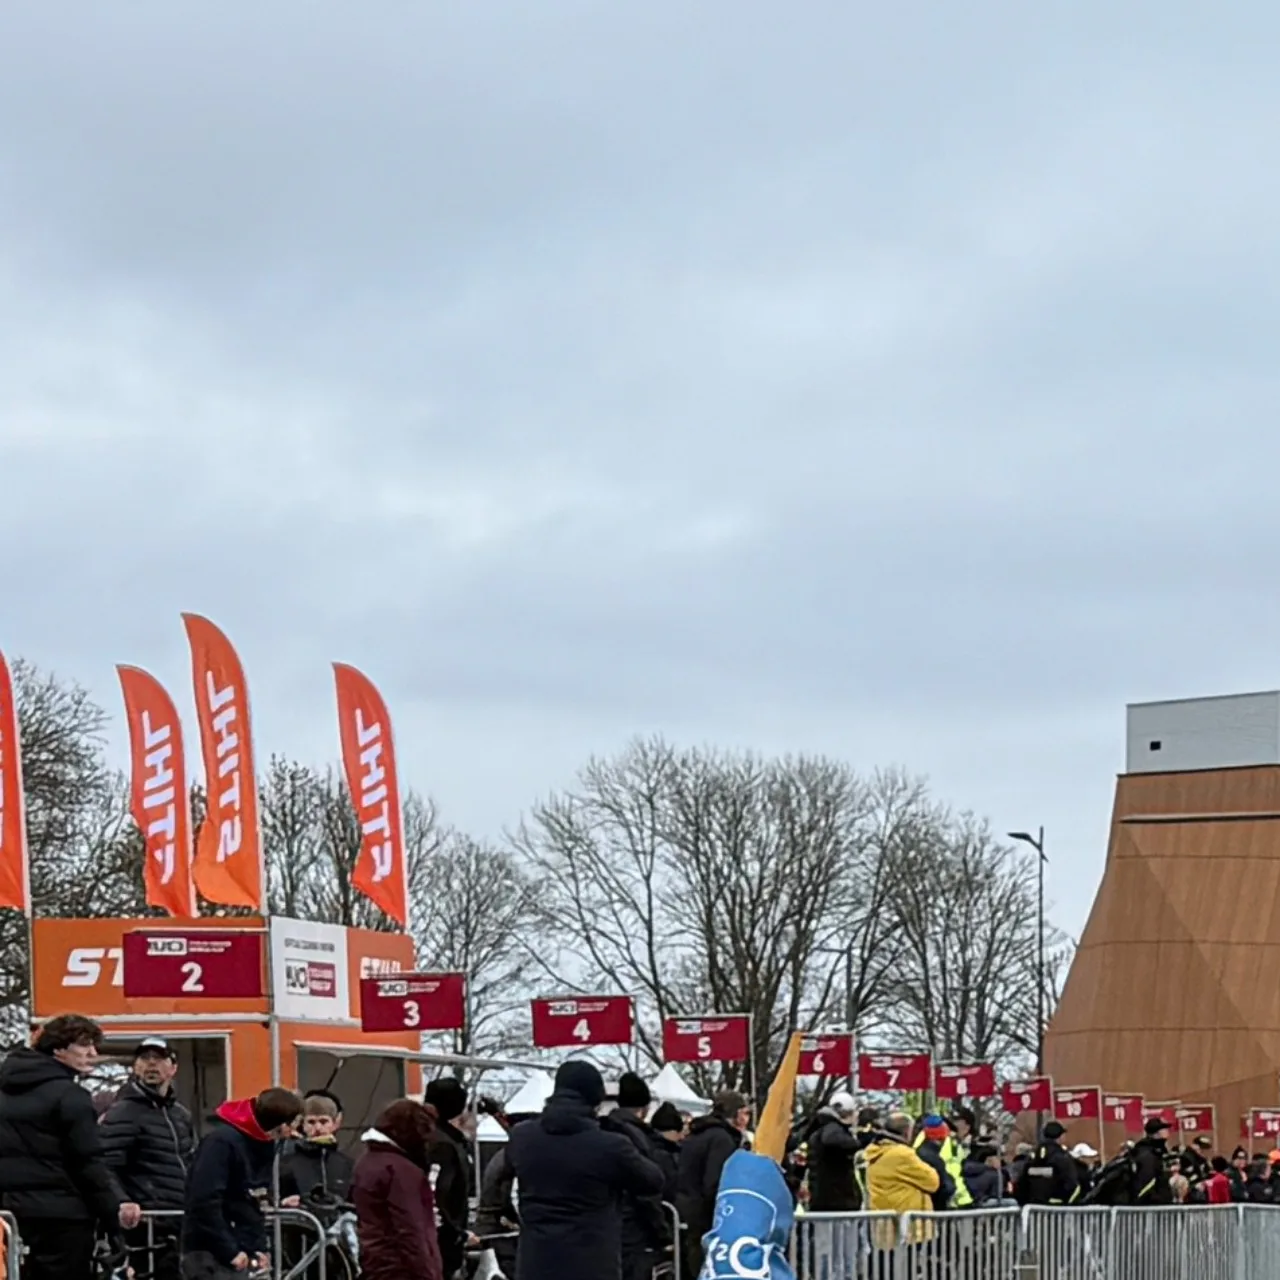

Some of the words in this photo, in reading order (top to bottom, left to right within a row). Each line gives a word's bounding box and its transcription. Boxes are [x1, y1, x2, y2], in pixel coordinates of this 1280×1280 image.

[180, 961, 205, 992] 2
[403, 1000, 421, 1027] 3
[573, 1018, 591, 1041] 4
[697, 1036, 711, 1058] 5
[812, 1053, 825, 1072] 6
[886, 1069, 900, 1087] 7
